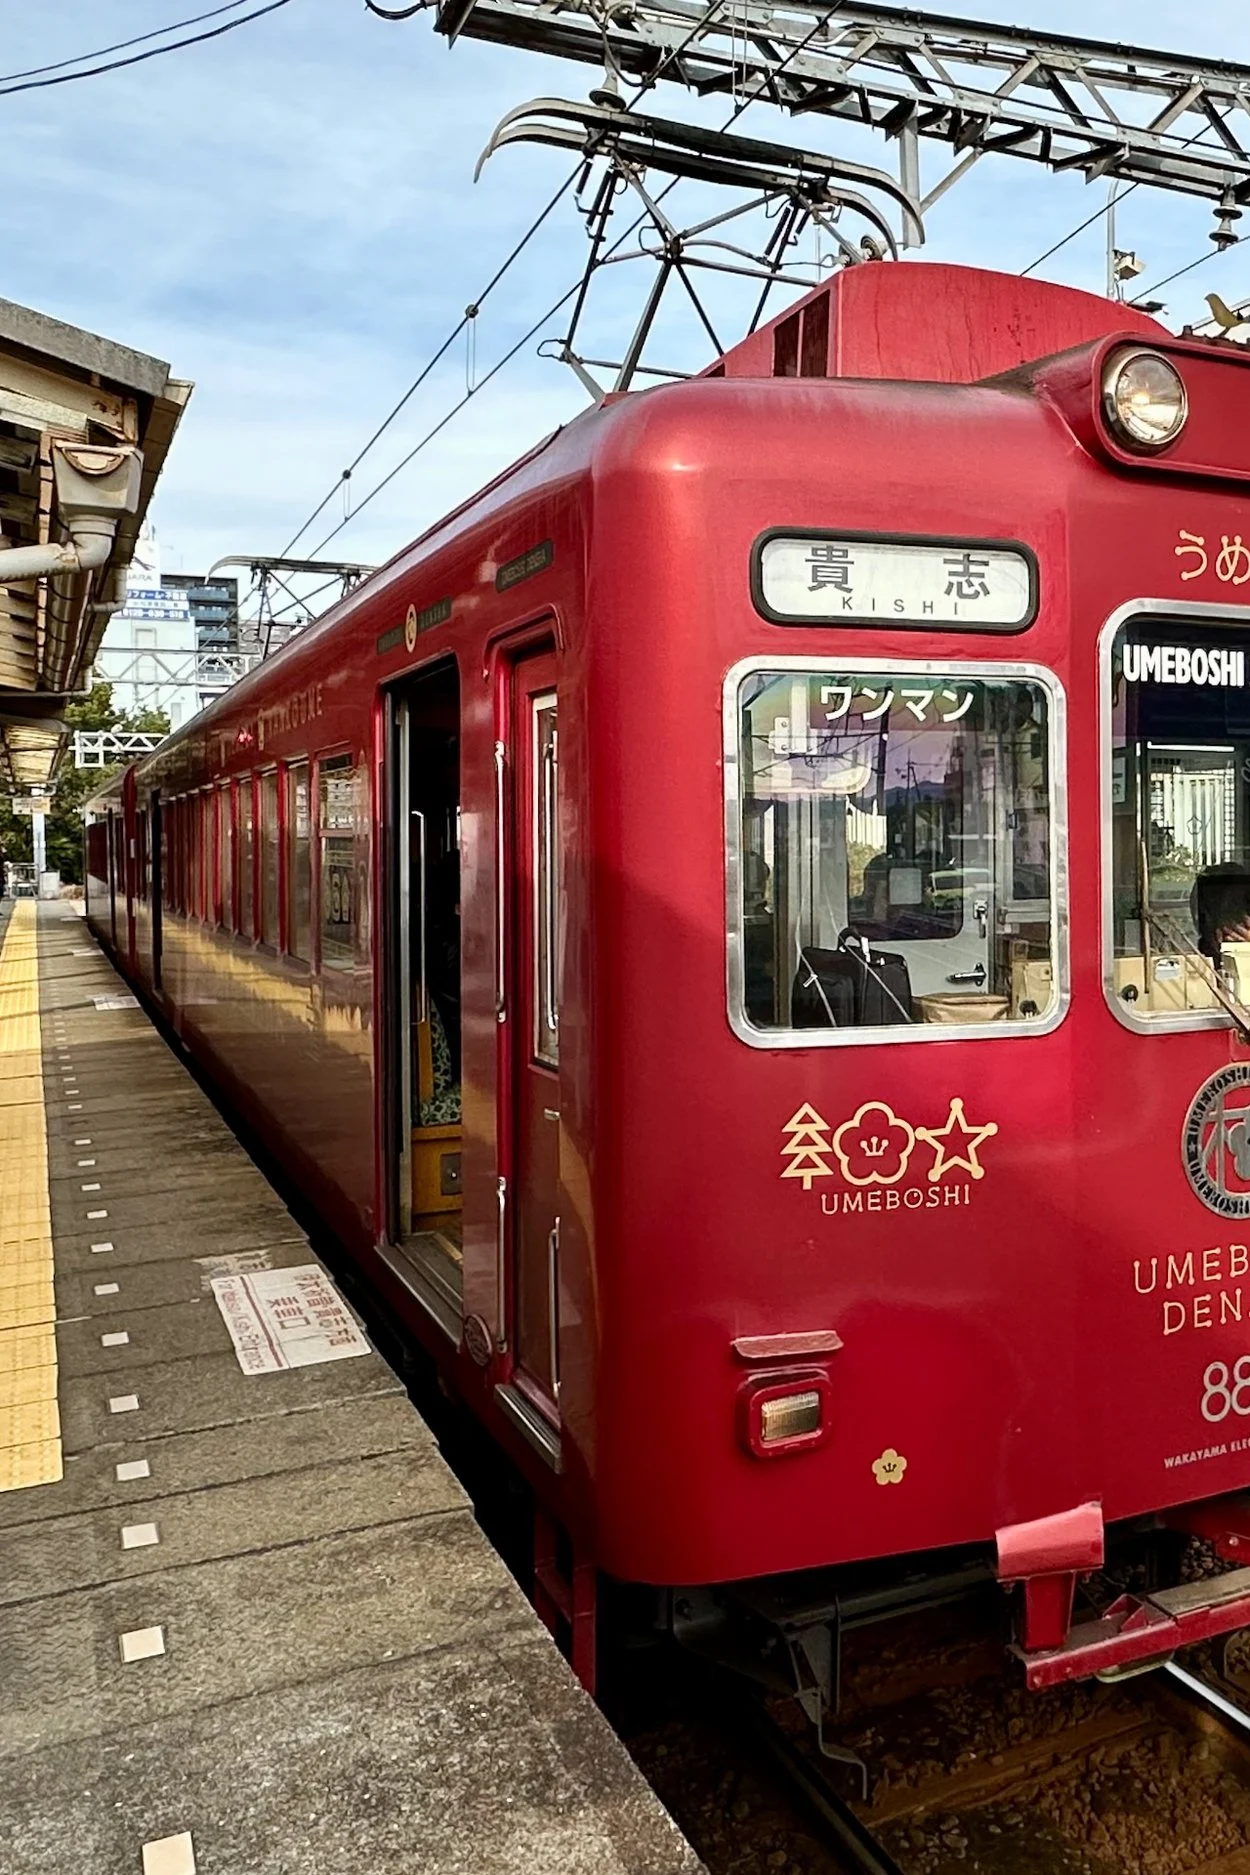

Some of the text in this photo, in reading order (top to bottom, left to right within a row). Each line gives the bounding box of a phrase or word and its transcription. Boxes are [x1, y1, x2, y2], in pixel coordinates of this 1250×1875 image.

[804, 545, 991, 600] 貴志
[841, 596, 959, 616] KISHI
[1122, 644, 1246, 688] UMEBOSHI
[820, 685, 974, 723] ワンマン
[820, 1184, 971, 1215] UMEBOSHI
[1163, 1444, 1228, 1469] WAKAYAMA
